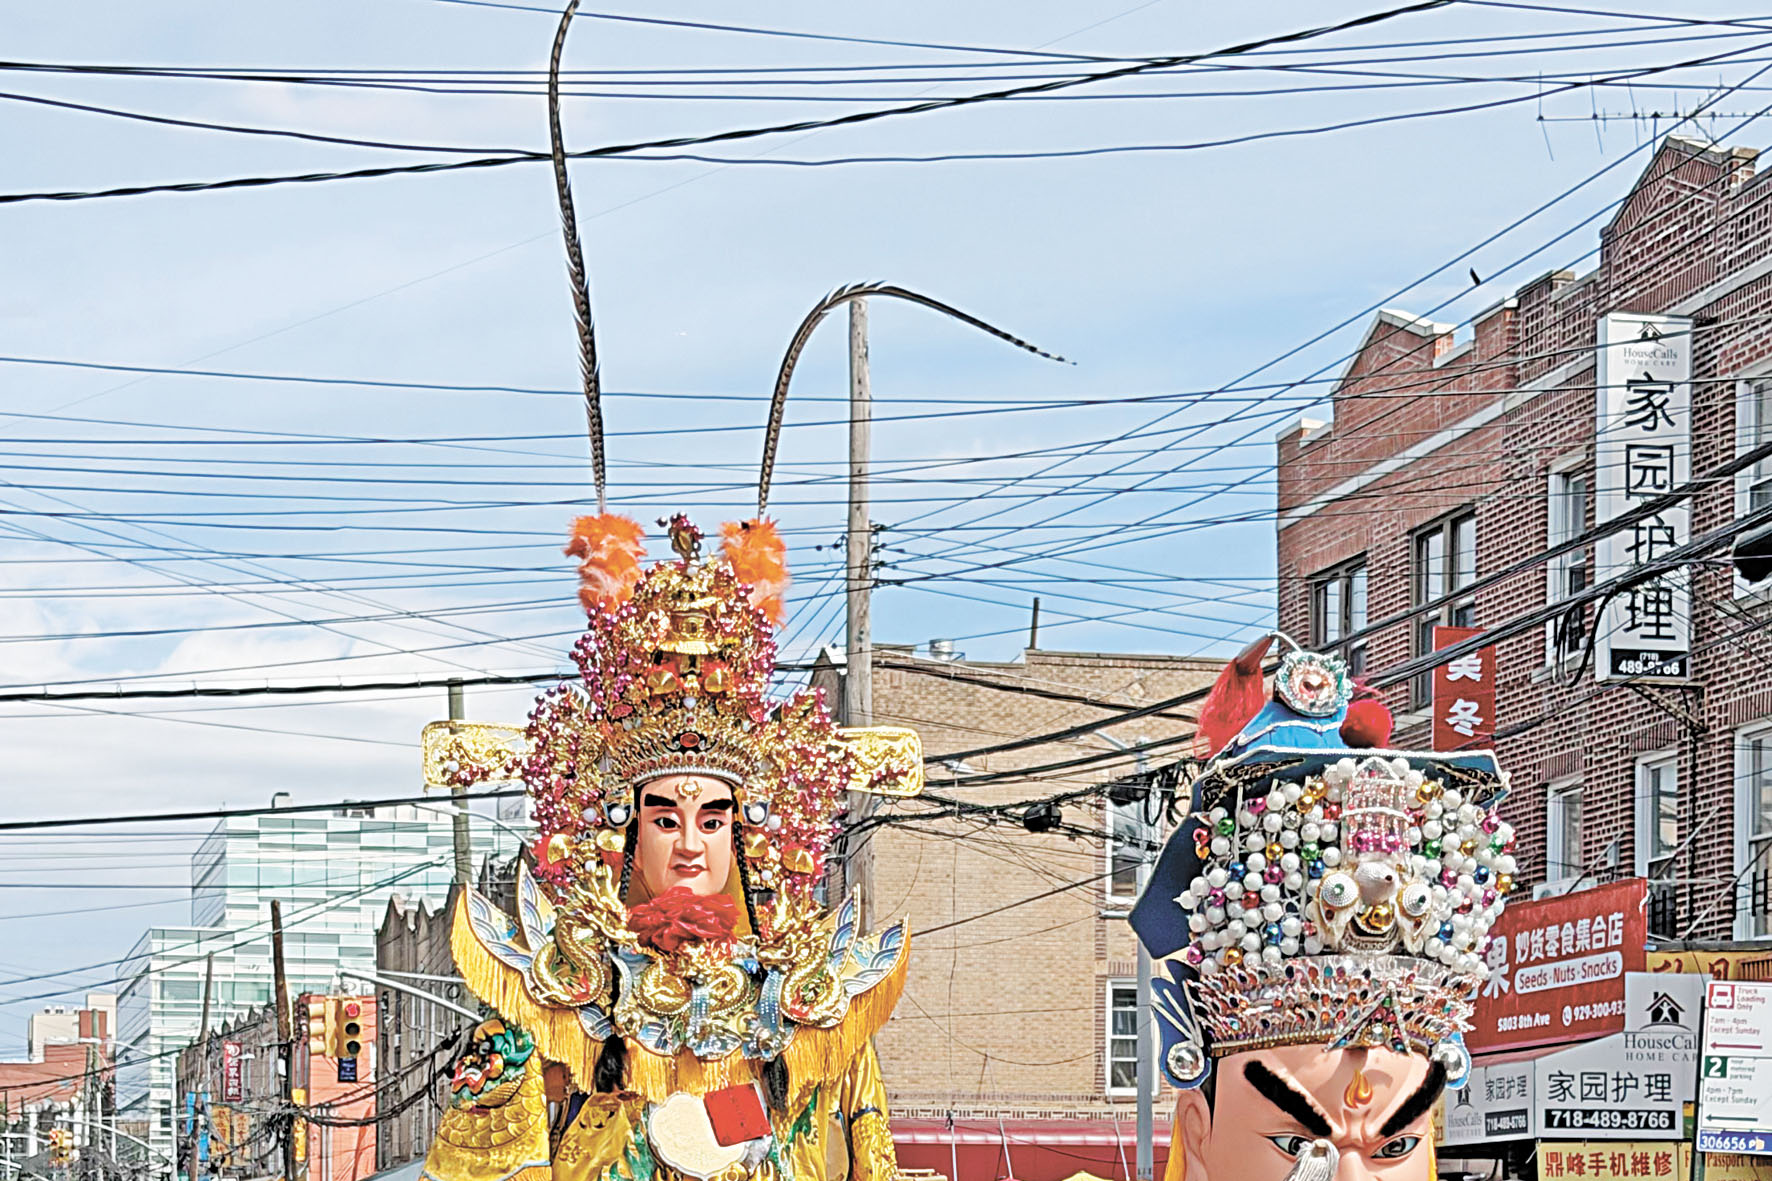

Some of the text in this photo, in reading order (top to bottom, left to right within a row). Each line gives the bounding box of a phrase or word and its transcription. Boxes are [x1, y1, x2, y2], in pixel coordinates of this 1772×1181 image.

[1623, 347, 1678, 359] HouseCalls
[1515, 912, 1624, 964] 炒货零食集合店
[1519, 959, 1617, 990] Seeds Nuts Snacks
[1738, 986, 1758, 994] Truck
[1736, 996, 1766, 1004] Loading
[1736, 1004, 1753, 1012] Only
[1533, 1012, 1550, 1027] Ave
[1710, 1026, 1760, 1036] Except Sunday
[1625, 1052, 1665, 1062] HOME
[1708, 1057, 1723, 1077] 2
[1547, 1070, 1673, 1103] 家园护理
[1705, 1095, 1758, 1105] Except Sunday
[1551, 1110, 1670, 1129] 718-489-8766
[1700, 1135, 1747, 1150] 306656
[1706, 1152, 1744, 1172] Passport
